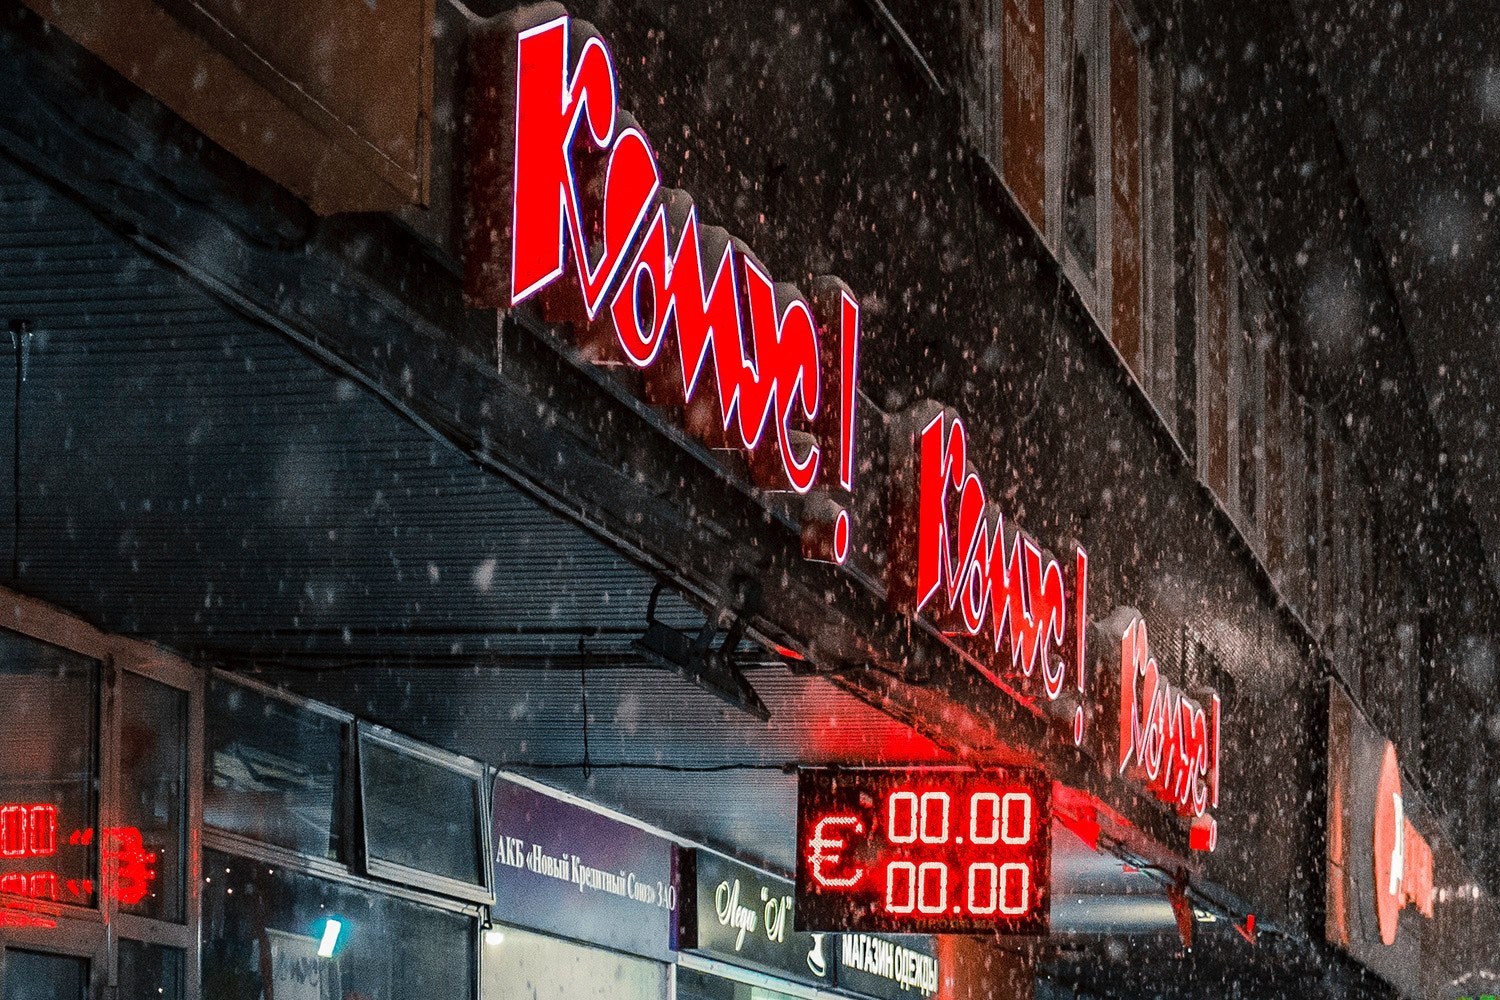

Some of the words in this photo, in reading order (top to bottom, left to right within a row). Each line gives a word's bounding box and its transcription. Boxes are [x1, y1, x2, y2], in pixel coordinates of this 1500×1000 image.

[888, 791, 1032, 845] 00.00
[496, 835, 524, 868] АКБ
[526, 844, 570, 882] «Новый
[570, 854, 627, 896] Кредитный
[657, 881, 676, 911] ЗАО
[885, 861, 1030, 915] 00.00
[842, 933, 895, 980] МАГАЗИН
[894, 945, 939, 998] ОДЕЖДЫ
